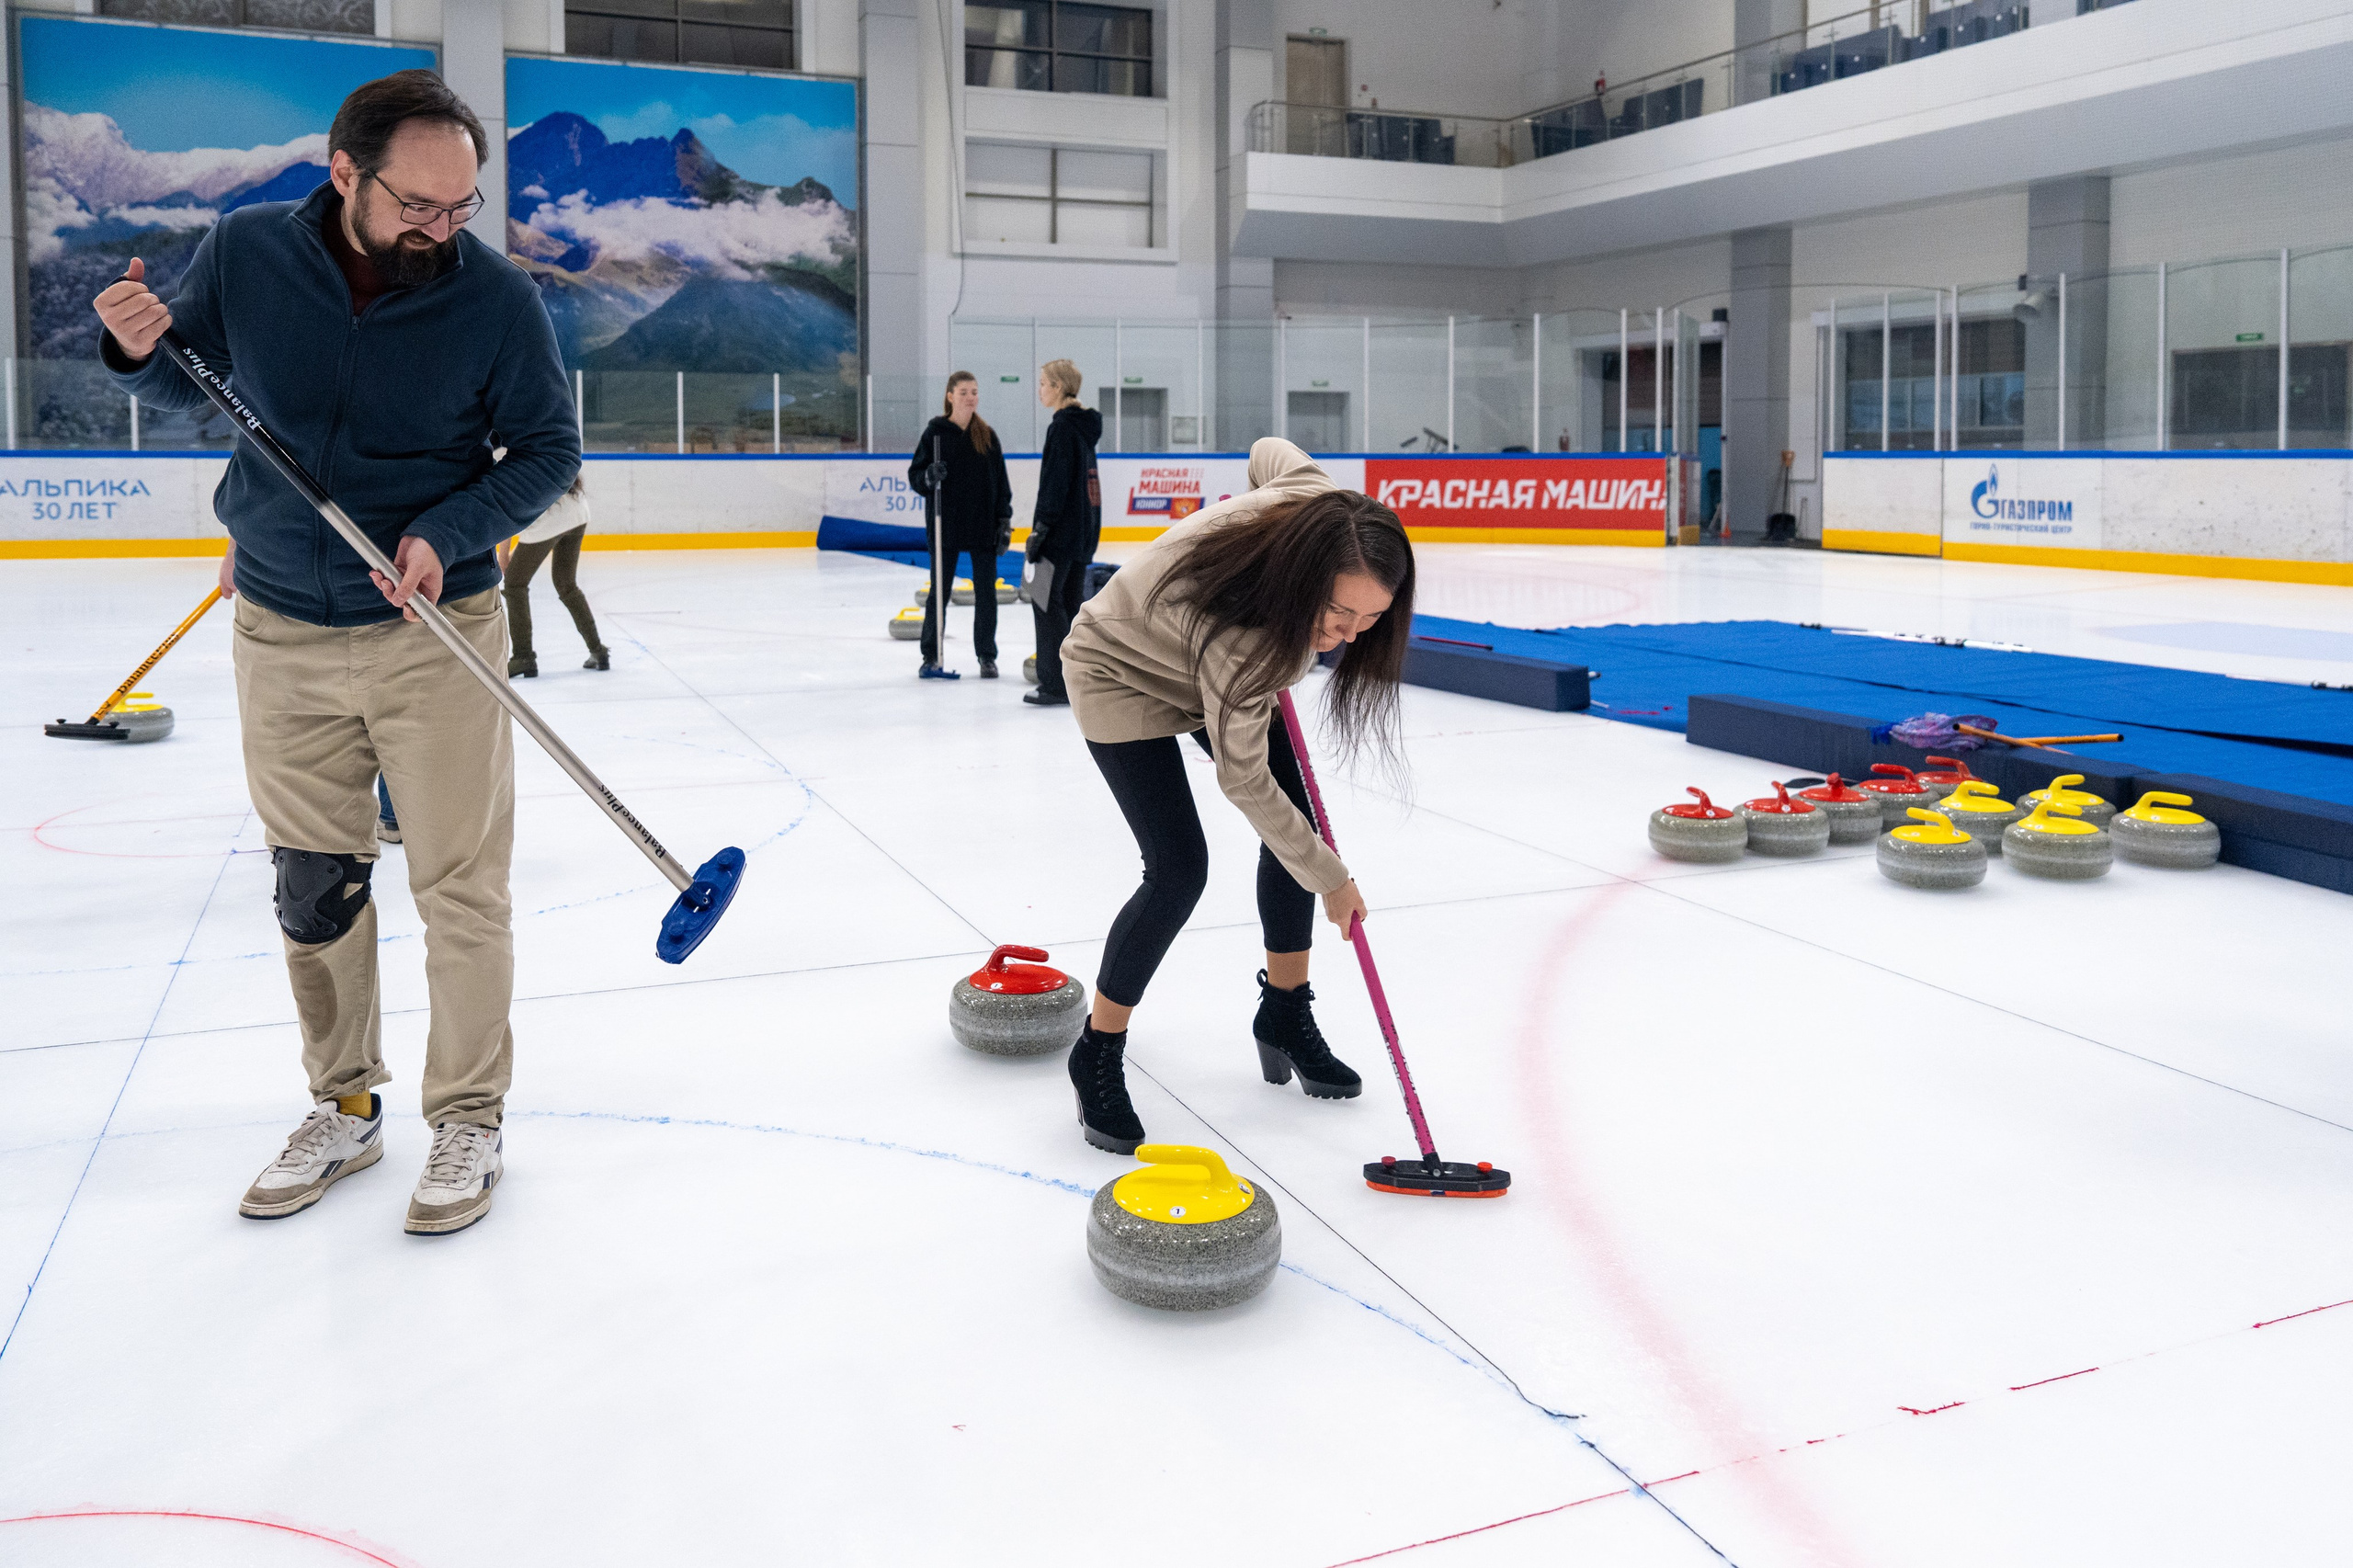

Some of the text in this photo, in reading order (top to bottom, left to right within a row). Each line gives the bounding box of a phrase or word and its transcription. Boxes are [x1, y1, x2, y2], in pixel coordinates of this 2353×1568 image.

[183, 347, 262, 431] BalancePlus
[0, 479, 151, 497] АЛЬПИКА
[1138, 480, 1201, 494] МАШИНА
[1378, 479, 1538, 509] КРАСНАЯ
[32, 502, 118, 520] 30 ЛЕТ
[885, 495, 906, 512] 30
[2000, 499, 2074, 521] ГАЗПРОМ
[597, 784, 666, 859] BalancePlus
